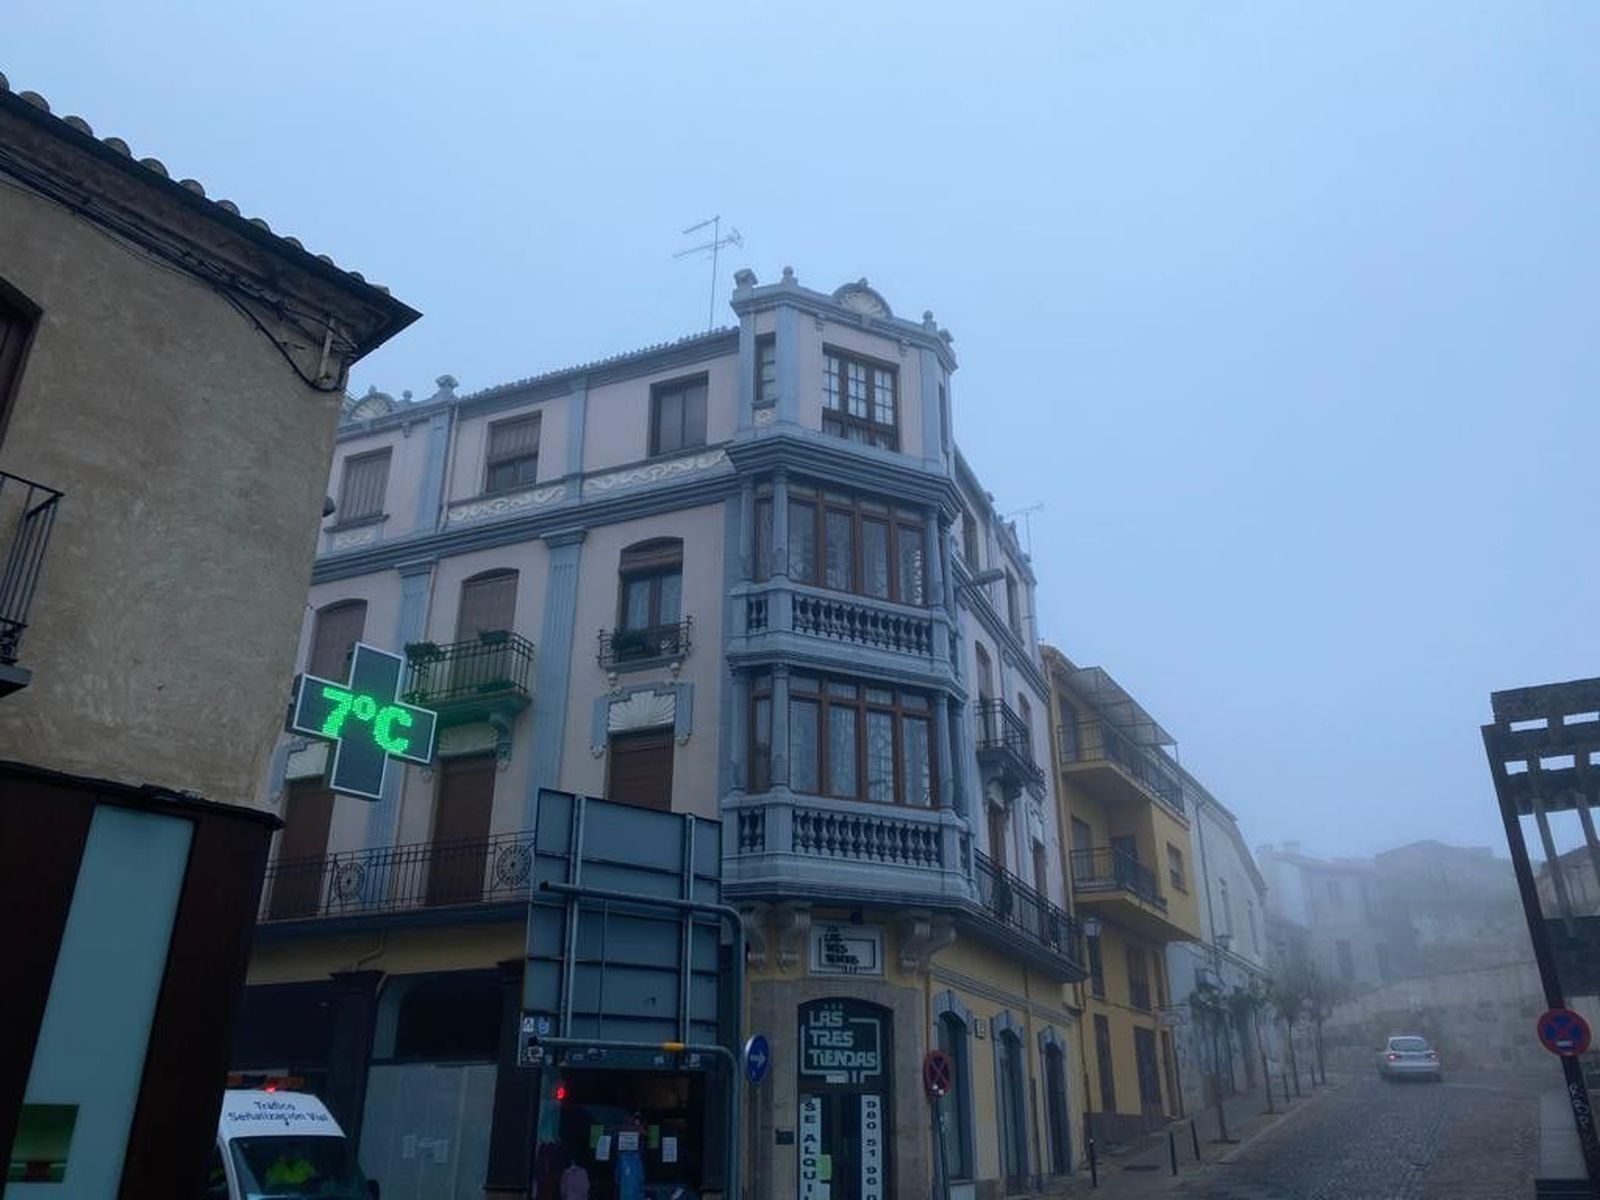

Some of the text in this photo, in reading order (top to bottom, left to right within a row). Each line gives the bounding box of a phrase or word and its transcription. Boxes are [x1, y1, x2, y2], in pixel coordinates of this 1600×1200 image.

[808, 1010, 844, 1027] LAS
[809, 1029, 854, 1047] TRES
[808, 1049, 876, 1068] TIENDAS
